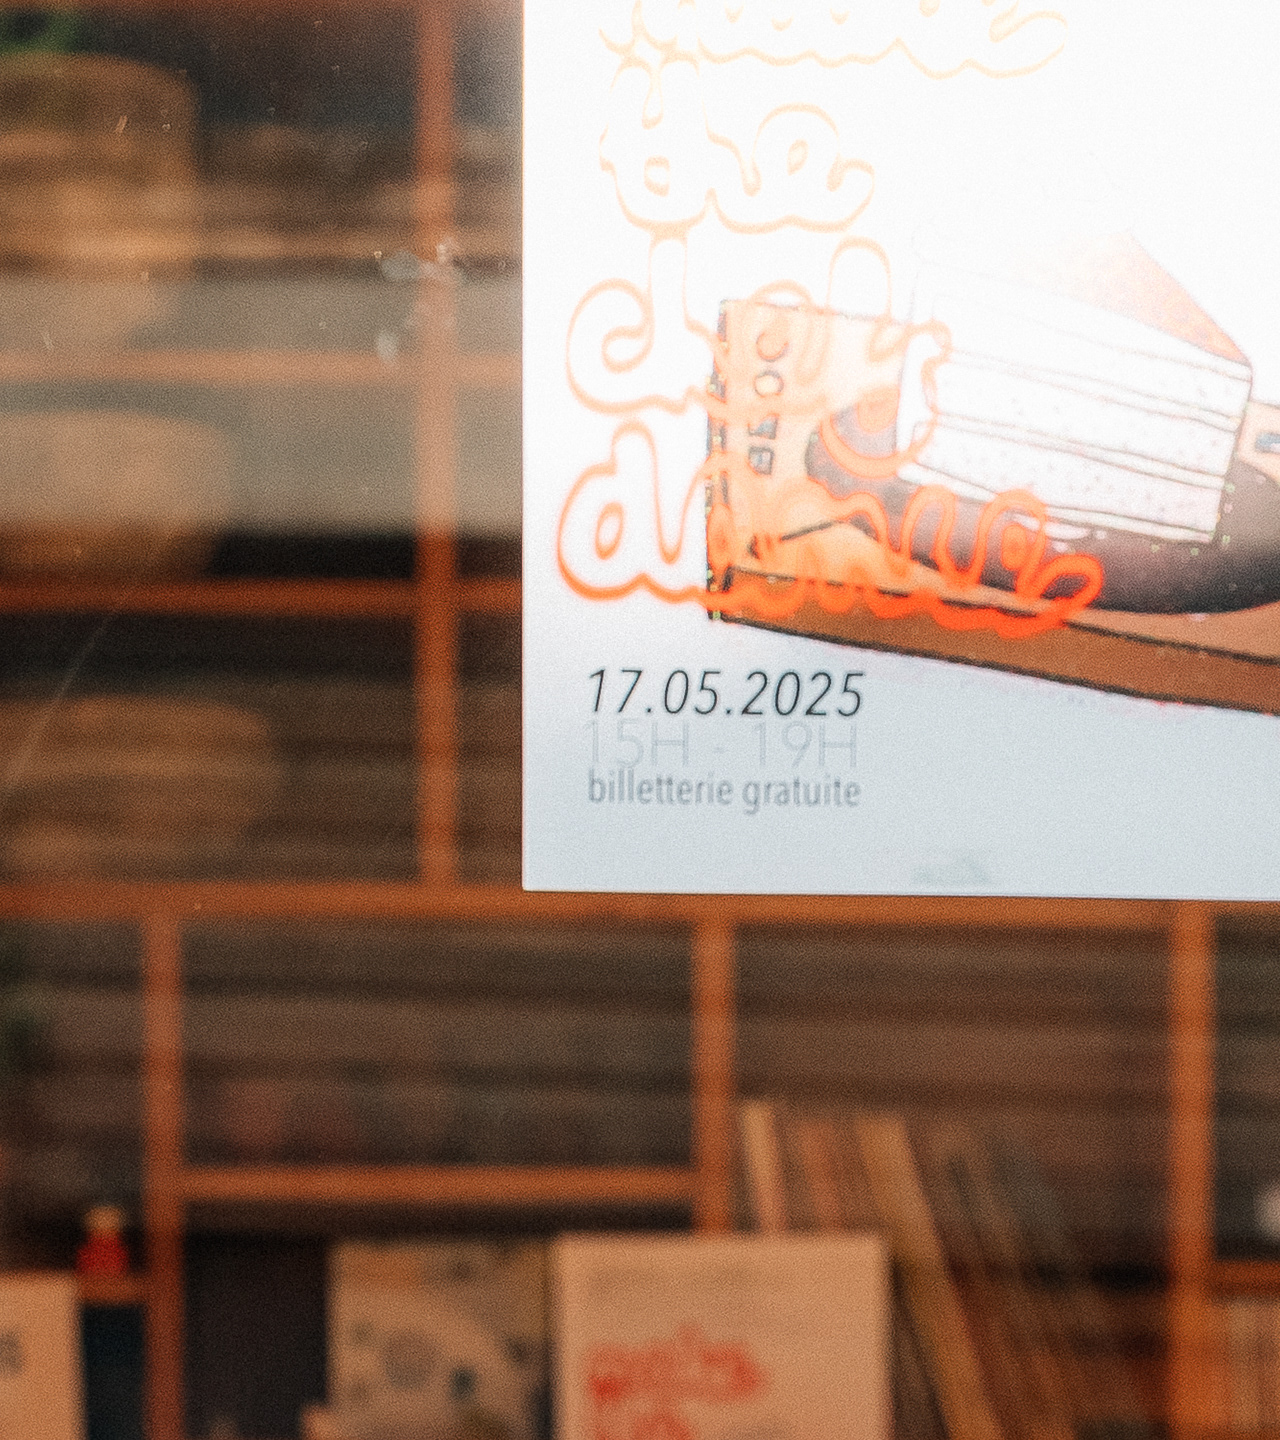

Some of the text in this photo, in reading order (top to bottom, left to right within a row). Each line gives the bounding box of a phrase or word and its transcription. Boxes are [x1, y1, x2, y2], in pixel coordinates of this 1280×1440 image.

[589, 667, 866, 718] 17.05.2025
[586, 767, 863, 817] billetterie gratuite
